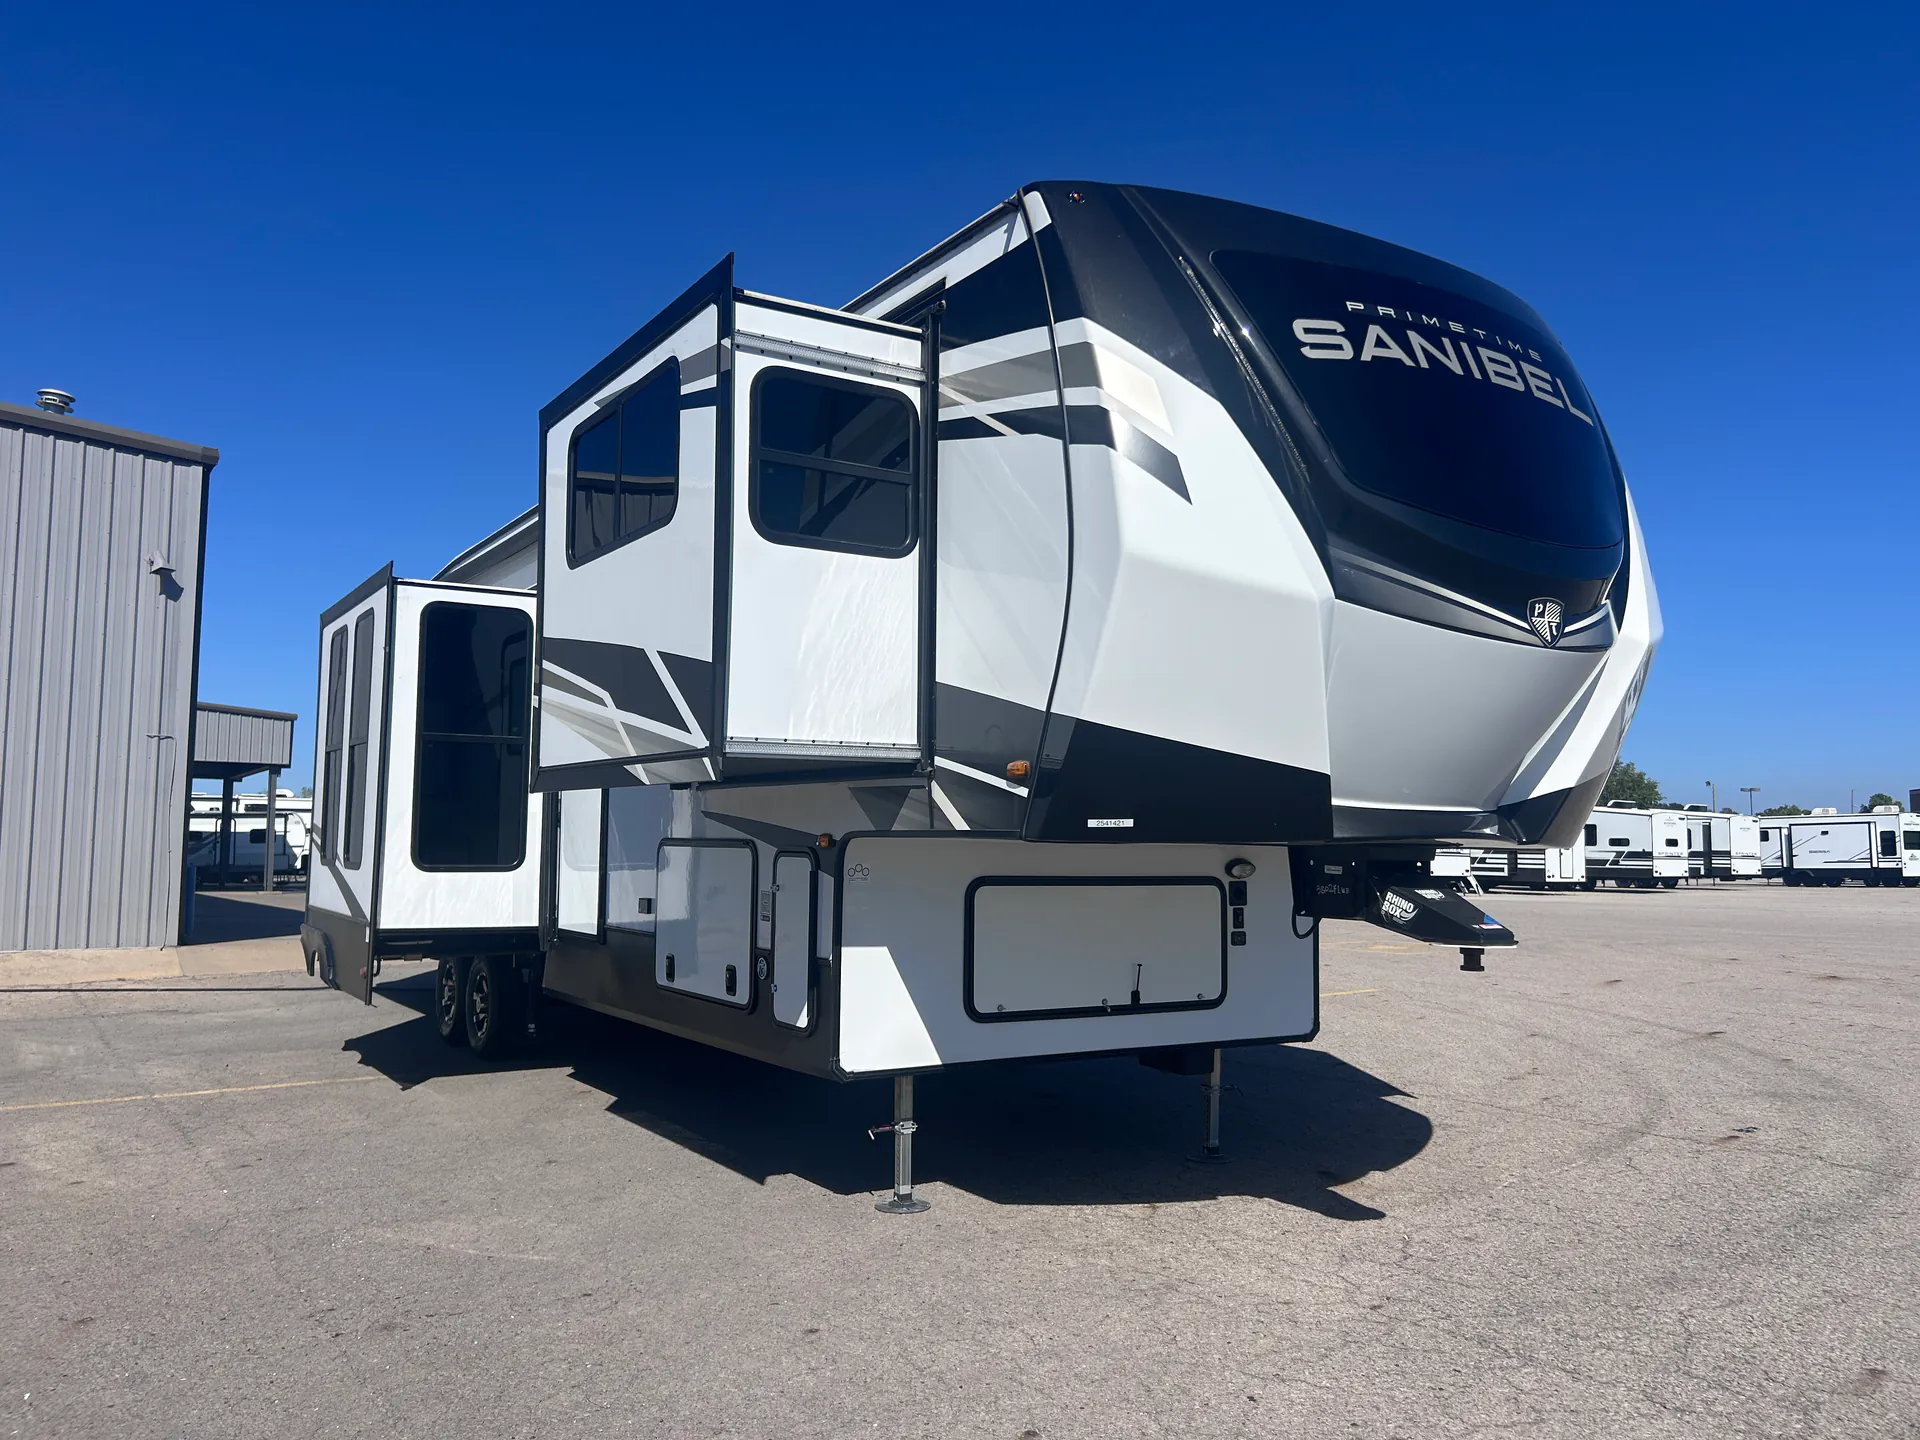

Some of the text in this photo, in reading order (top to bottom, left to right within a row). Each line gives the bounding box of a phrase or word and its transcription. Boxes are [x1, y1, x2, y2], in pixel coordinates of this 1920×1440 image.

[1292, 318, 1595, 427] SANIBEL
[1381, 900, 1404, 919] BOX
[1385, 891, 1415, 913] RHINO
